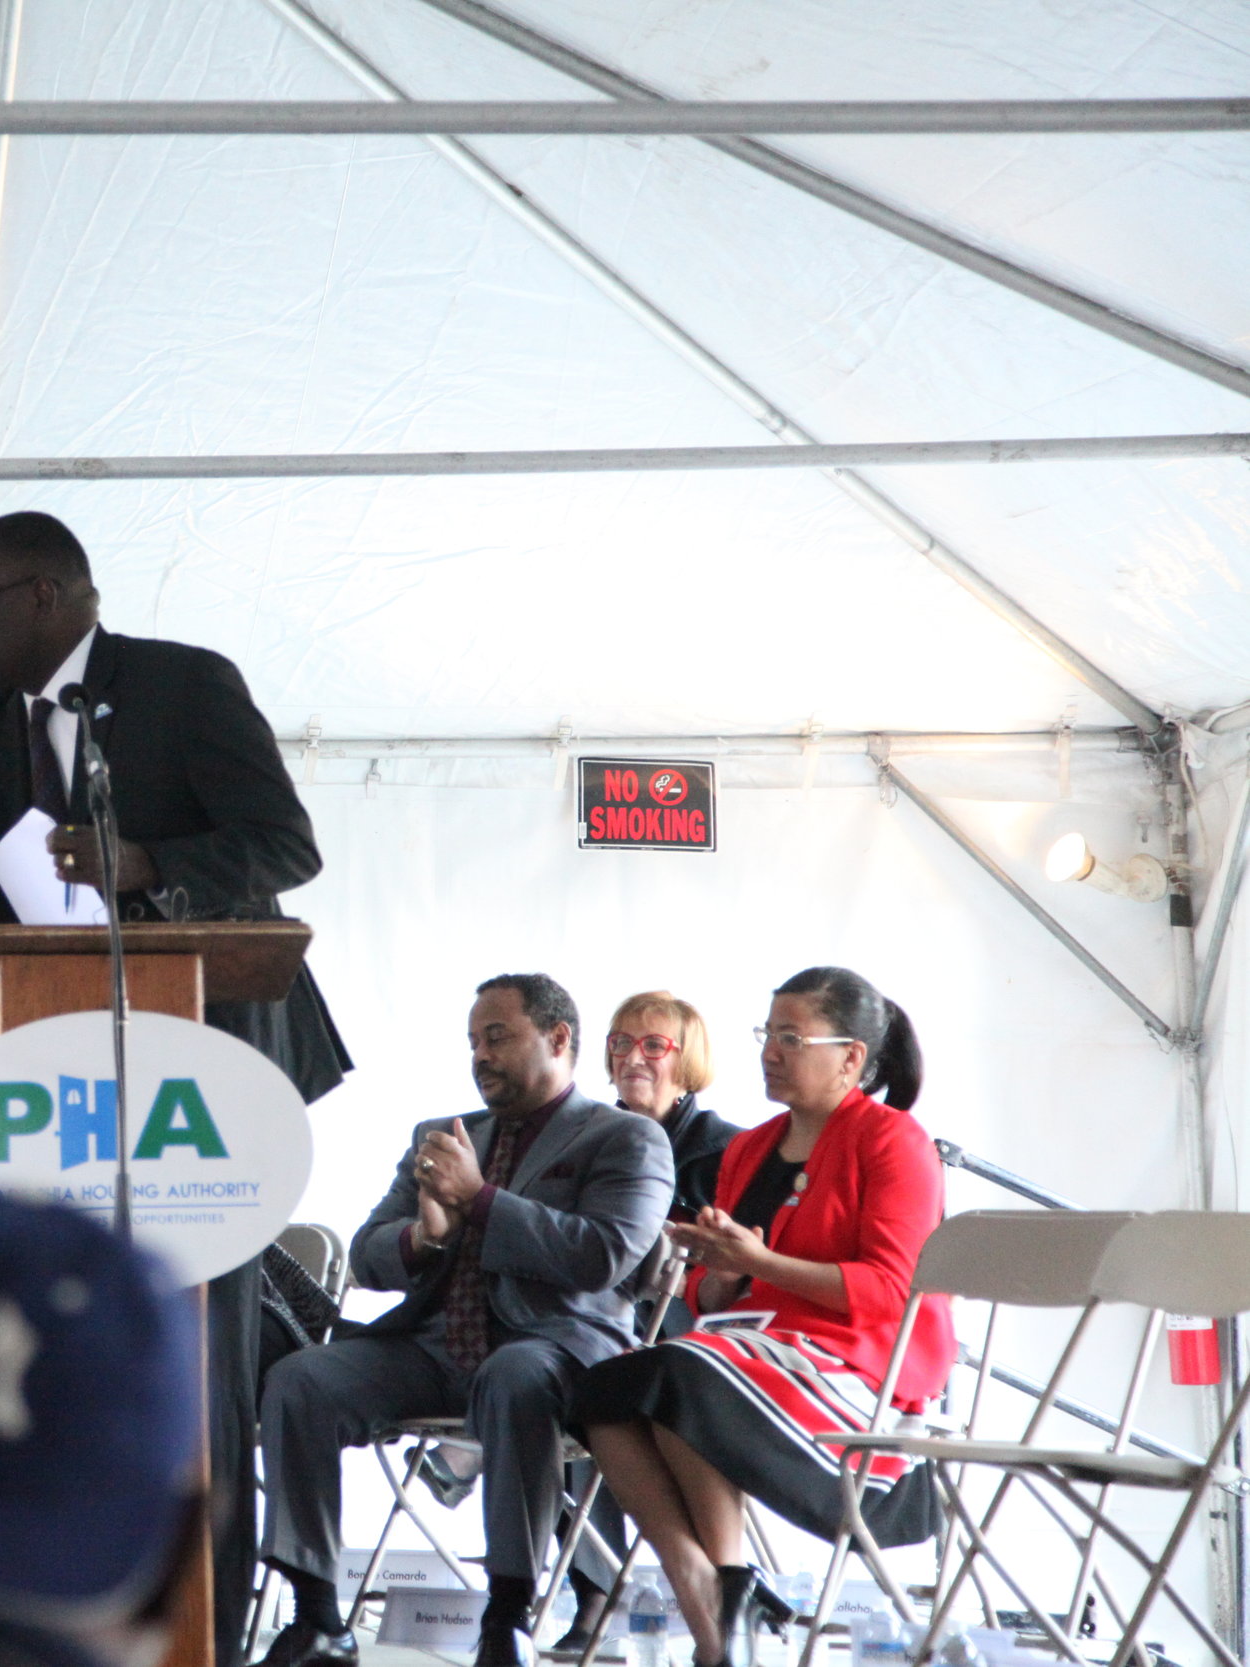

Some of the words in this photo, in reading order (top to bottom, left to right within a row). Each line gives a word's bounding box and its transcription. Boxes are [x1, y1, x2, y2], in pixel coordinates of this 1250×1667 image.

[604, 769, 639, 803] NO
[589, 806, 706, 843] SMOKING
[81, 1183, 159, 1200] HOUNG
[167, 1181, 260, 1199] AUTHORITY
[133, 1213, 225, 1225] OPPORTUNITIES
[382, 1570, 428, 1581] Camarda
[416, 1611, 438, 1624] Brian
